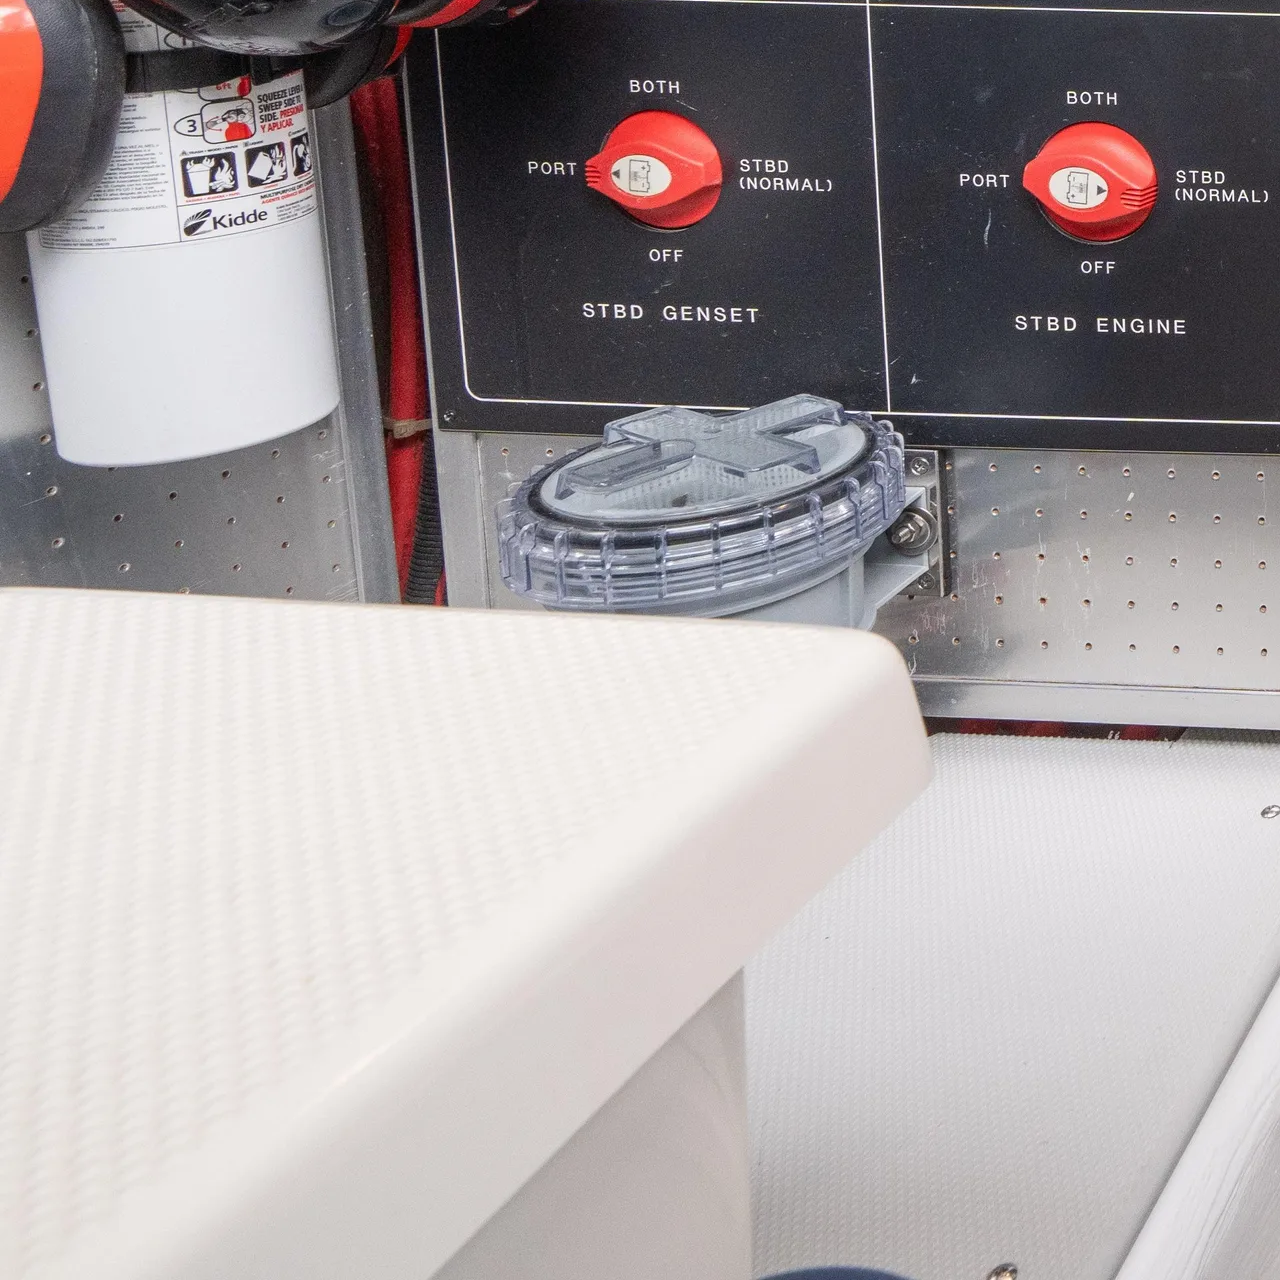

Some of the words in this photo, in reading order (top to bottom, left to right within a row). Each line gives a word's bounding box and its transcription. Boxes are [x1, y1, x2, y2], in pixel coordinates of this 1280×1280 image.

[629, 79, 680, 94] BOTH
[257, 89, 288, 103] SQUEEZE
[1066, 90, 1118, 106] BOTH
[259, 101, 283, 113] SWEEP
[186, 119, 197, 133] 3
[260, 125, 267, 133] Y
[527, 160, 577, 176] PORT
[739, 158, 789, 174] STBD
[739, 176, 833, 192] (NORMAL)
[959, 173, 1010, 188] PORT
[1175, 169, 1226, 185] STBD
[1174, 187, 1269, 203] (NORMAL)
[213, 209, 268, 230] Kidde
[648, 248, 684, 263] OFF
[1080, 260, 1116, 275] OFF
[582, 302, 644, 320] STBD
[662, 305, 759, 323] GENSET
[1014, 315, 1077, 332] STBD
[1096, 317, 1186, 335] ENGINE
